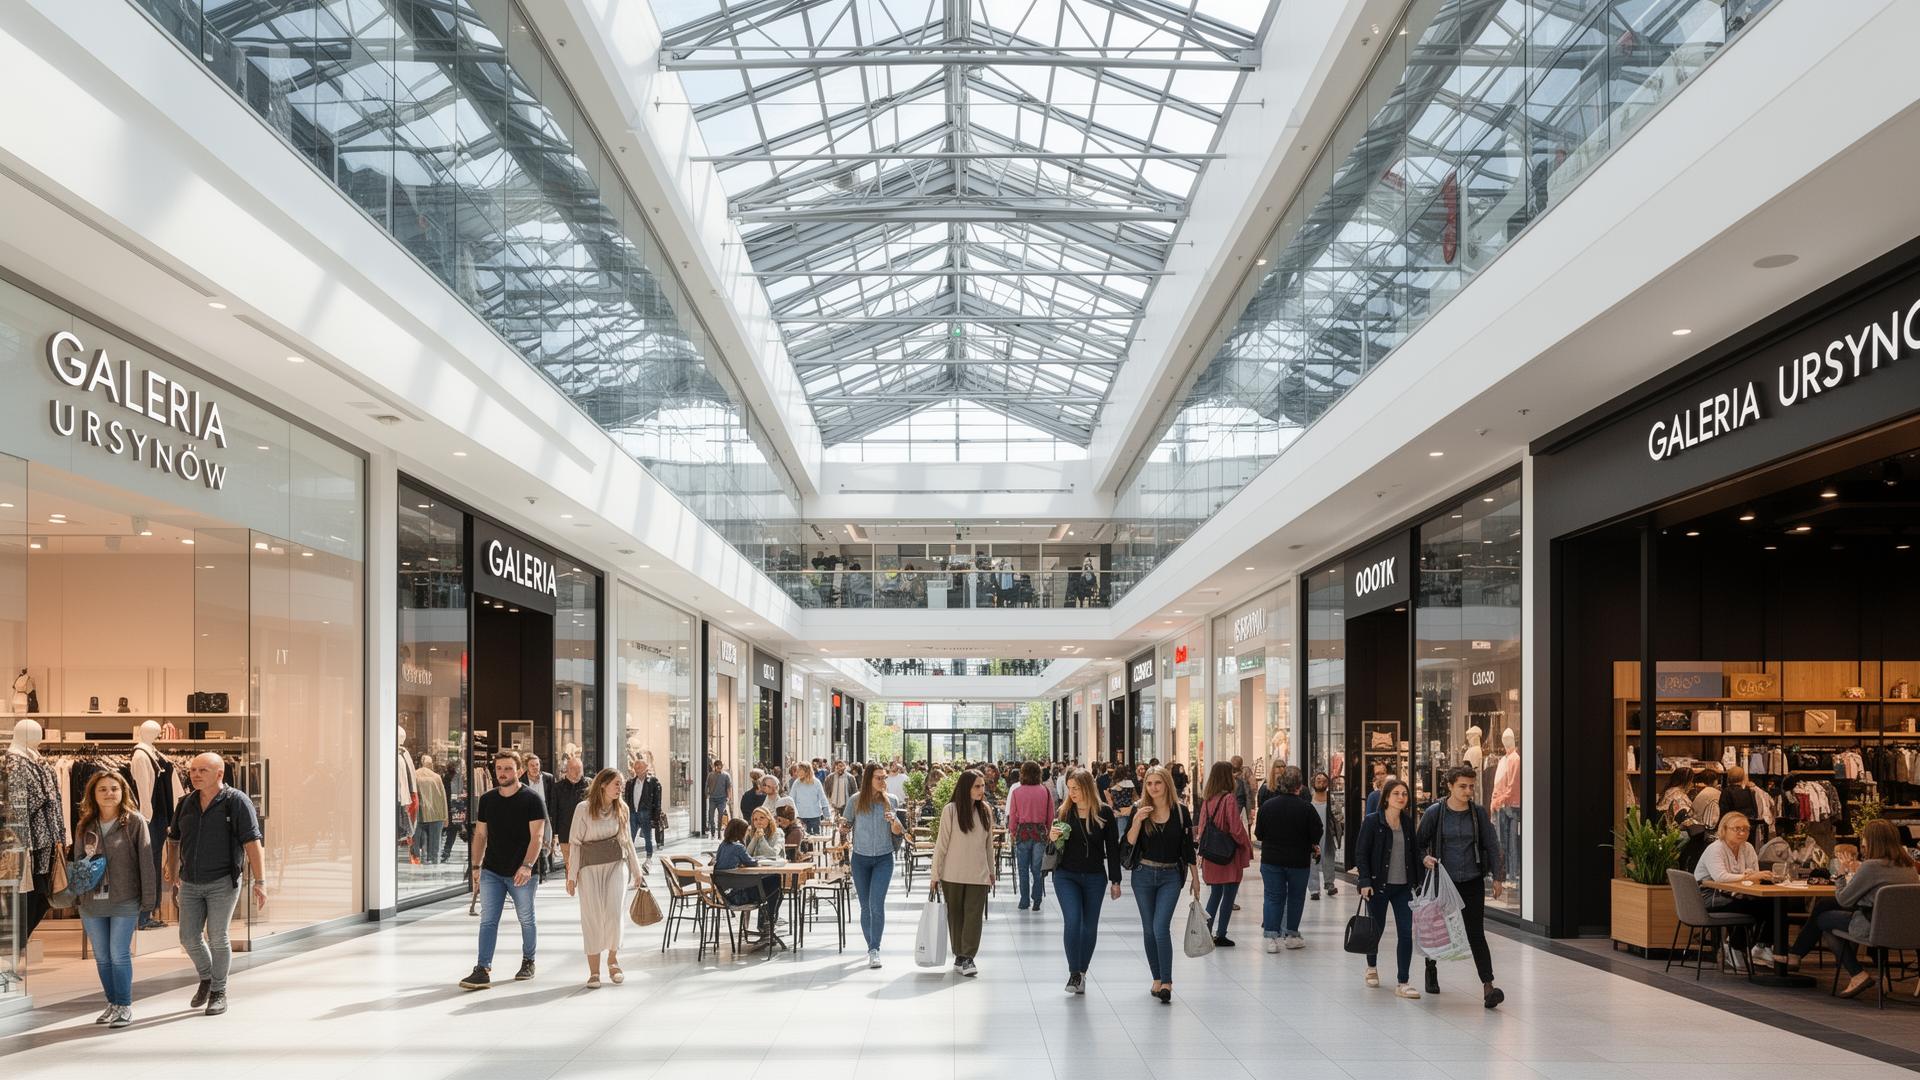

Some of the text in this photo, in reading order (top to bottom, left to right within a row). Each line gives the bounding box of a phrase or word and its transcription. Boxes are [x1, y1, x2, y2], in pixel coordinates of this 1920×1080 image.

[47, 331, 228, 449] GALERIA
[1648, 381, 1760, 461] GALERIA
[488, 539, 558, 598] GALERIA
